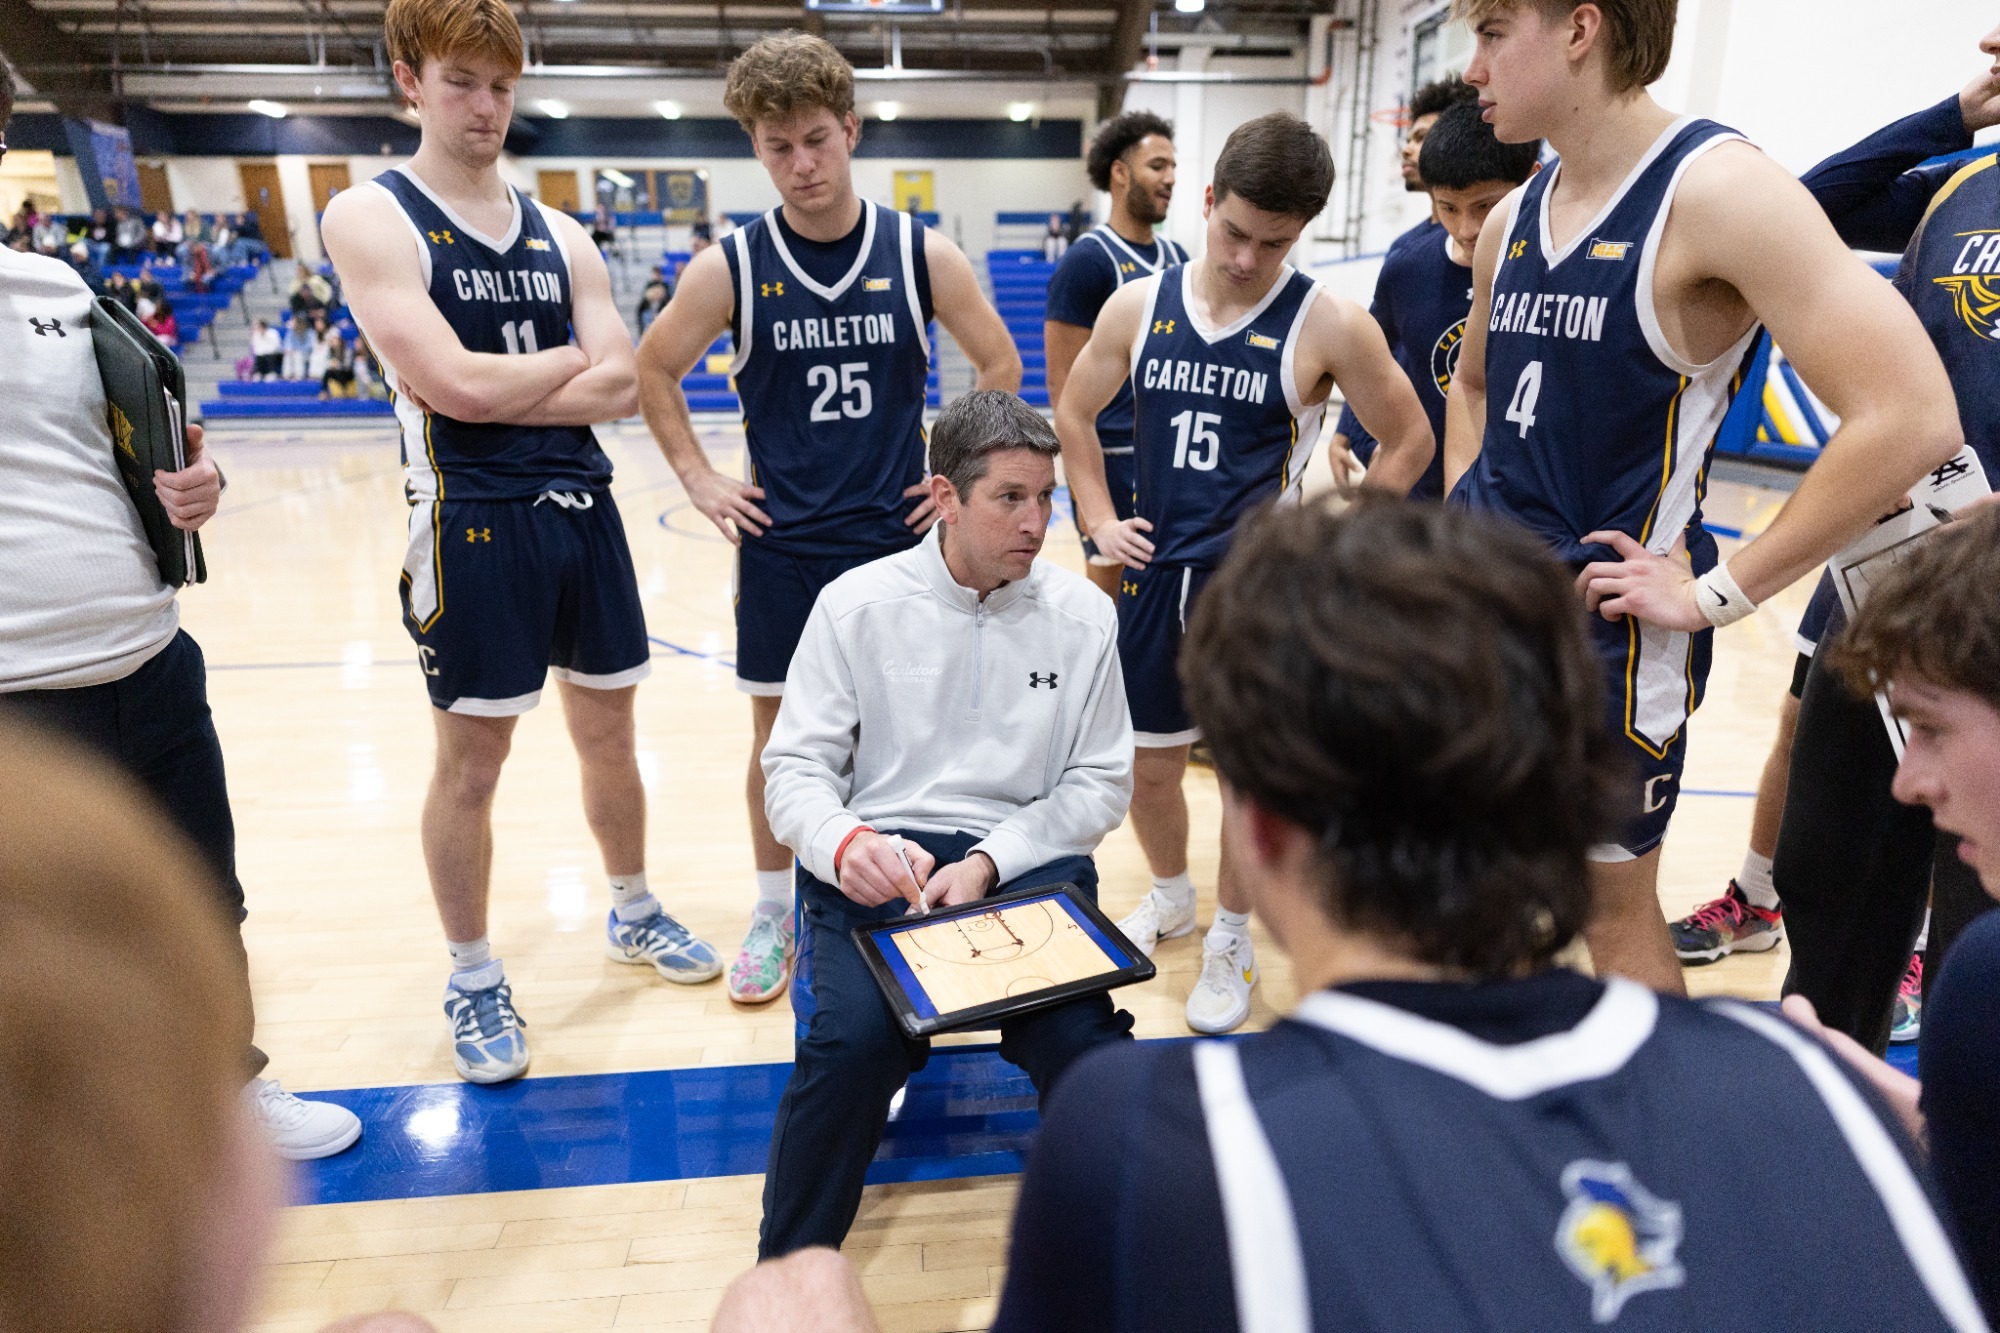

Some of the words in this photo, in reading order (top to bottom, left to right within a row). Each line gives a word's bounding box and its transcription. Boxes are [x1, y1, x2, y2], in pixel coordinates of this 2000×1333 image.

[1952, 234, 2000, 274] CA
[452, 268, 562, 303] CARLETON
[501, 319, 539, 354] 11
[773, 313, 896, 351] CARLETON
[1490, 292, 1609, 342] CARLETON
[806, 361, 873, 423] 25
[1143, 358, 1269, 405] CARLETON
[1505, 360, 1543, 440] 4
[1170, 410, 1222, 472] 15
[418, 644, 440, 676] C
[1643, 773, 1673, 813] C
